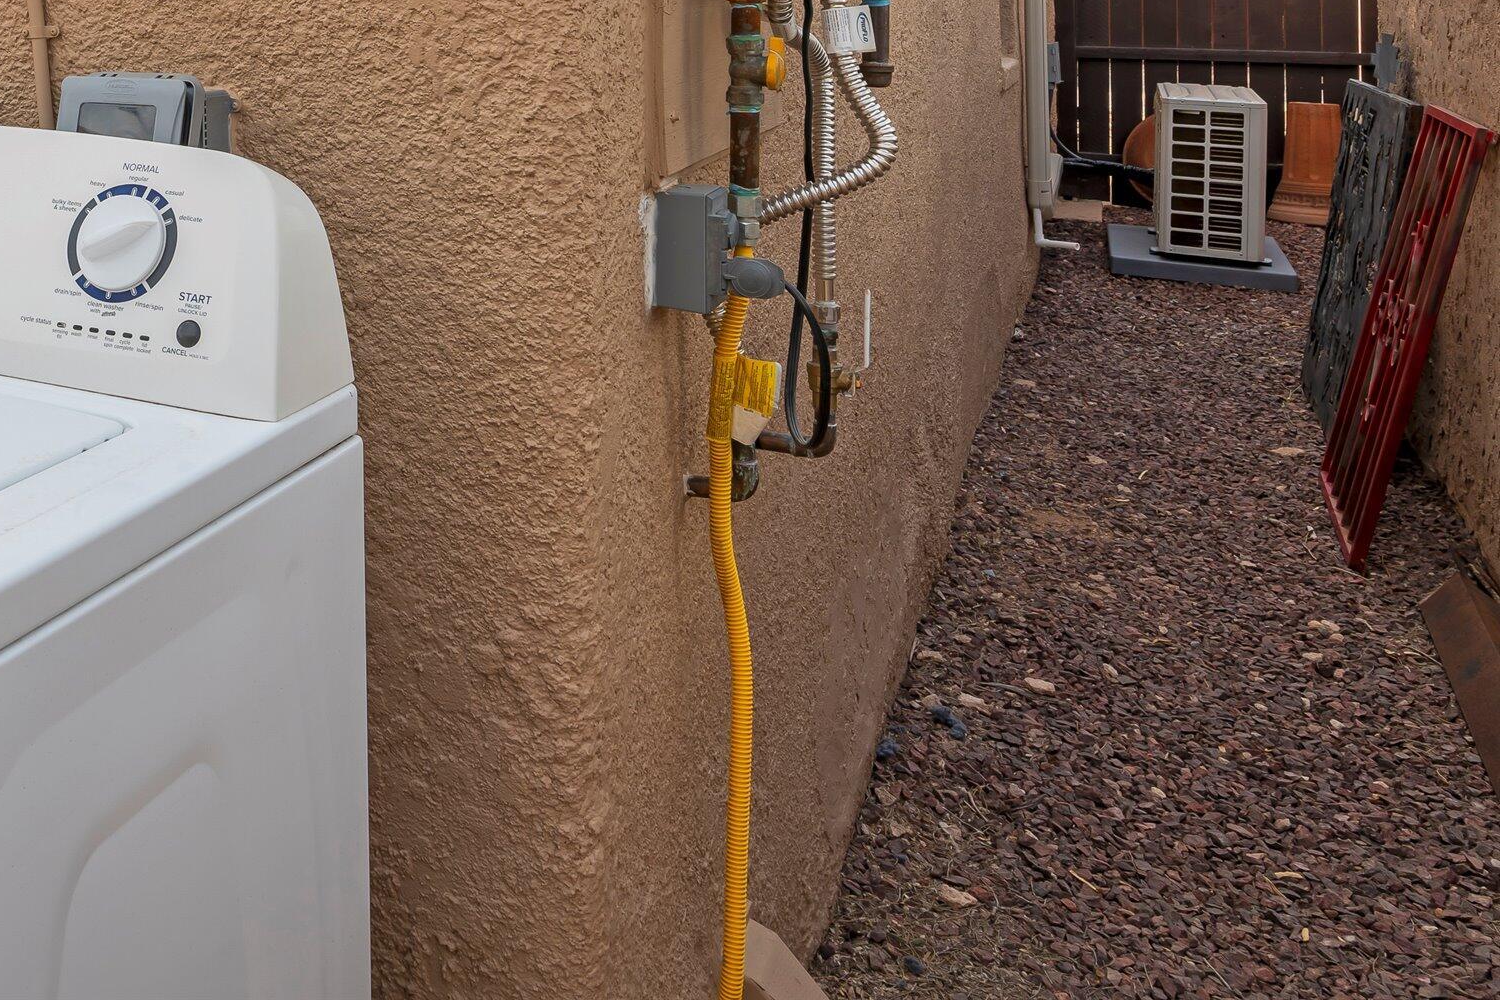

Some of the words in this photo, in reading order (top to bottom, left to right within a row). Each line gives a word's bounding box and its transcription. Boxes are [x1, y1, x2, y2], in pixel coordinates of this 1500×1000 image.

[122, 163, 160, 174] NORMAL
[90, 180, 106, 188] heavy
[52, 198, 66, 206] bulky
[67, 200, 82, 208] items
[178, 214, 203, 223] delicate
[54, 288, 82, 297] drain/spin
[178, 292, 212, 304] START
[87, 300, 102, 308] clean
[103, 302, 124, 311] washer
[134, 300, 164, 311] rinse/spin
[178, 308, 198, 316] UNLOCK
[36, 317, 52, 326] status
[161, 346, 188, 357] CANCEL
